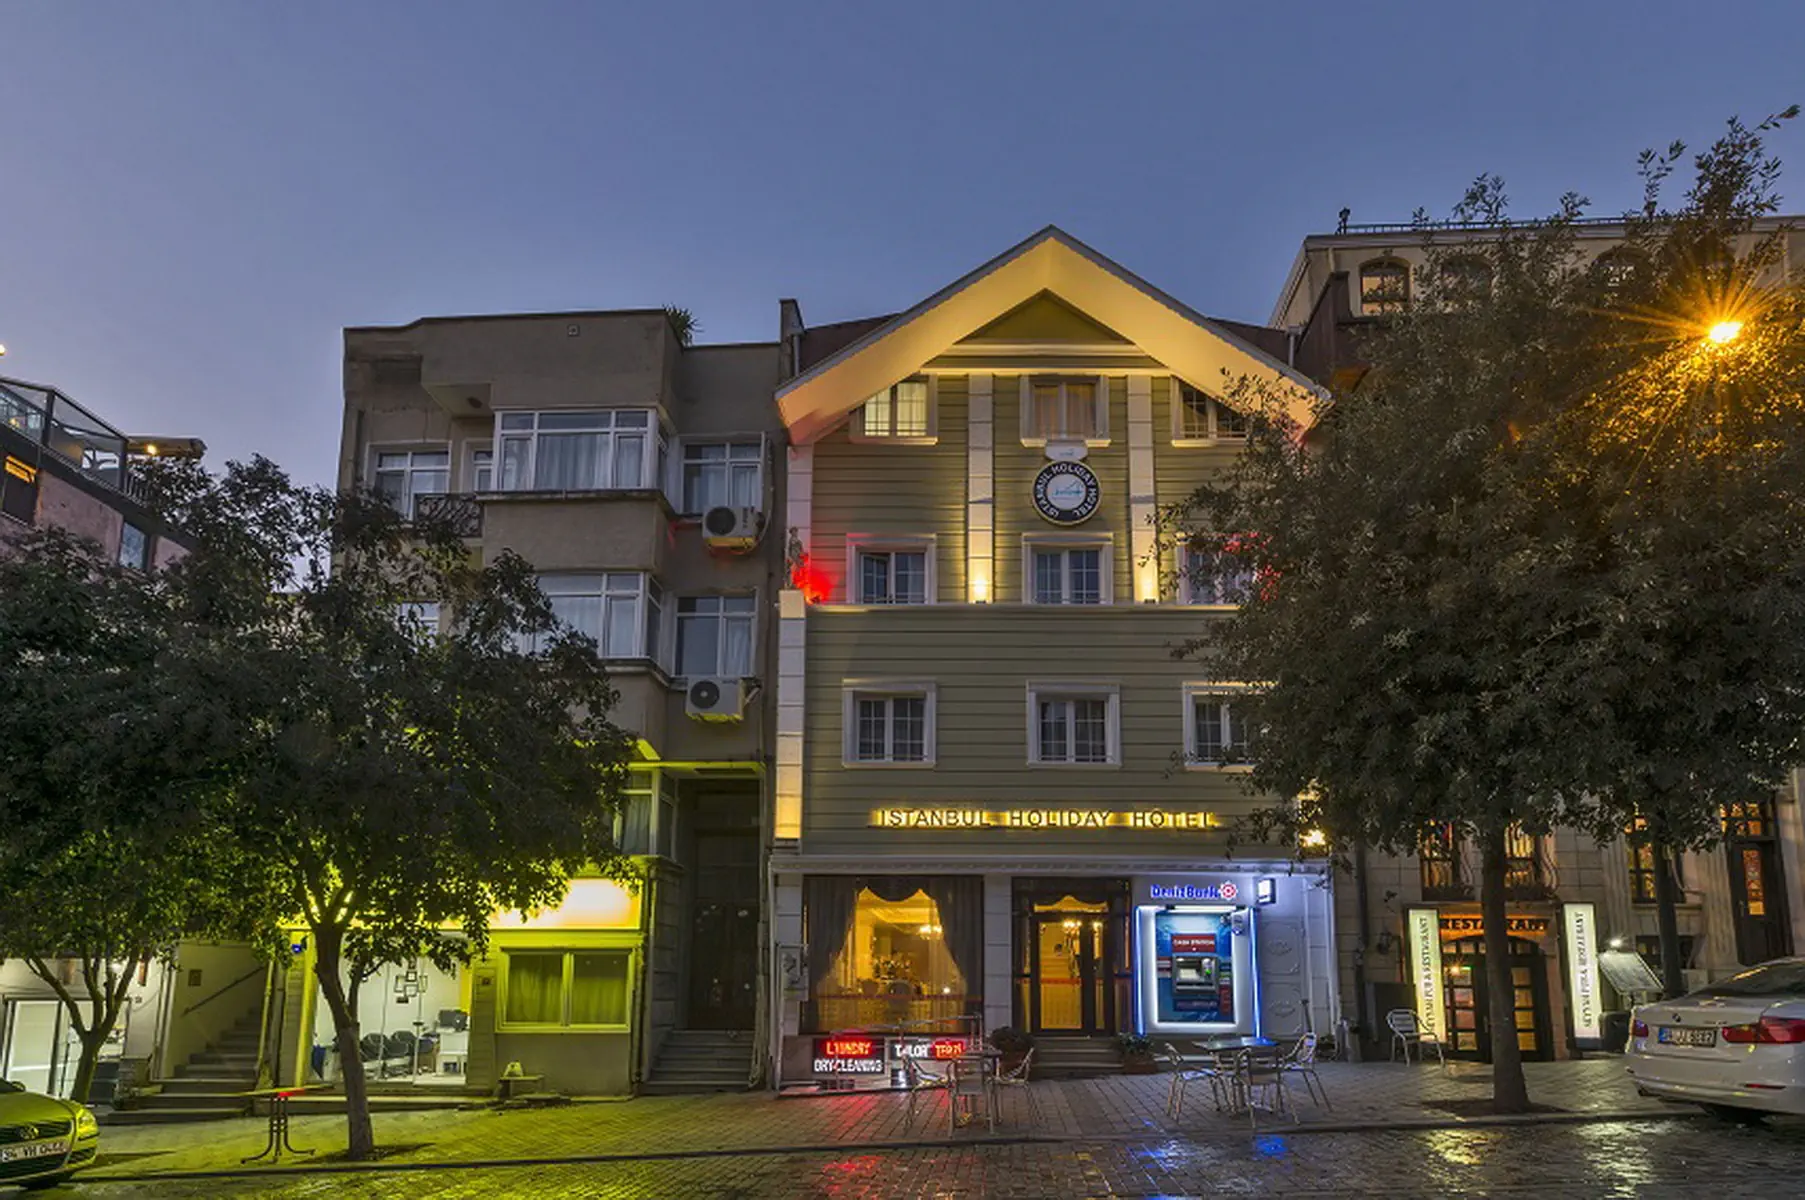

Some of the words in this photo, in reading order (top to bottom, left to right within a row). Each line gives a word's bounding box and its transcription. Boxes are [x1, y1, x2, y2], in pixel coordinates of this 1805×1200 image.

[881, 808, 990, 827] ISTANBUL
[1010, 809, 1112, 827] HOLIDAY
[1134, 809, 1219, 828] HOTEL
